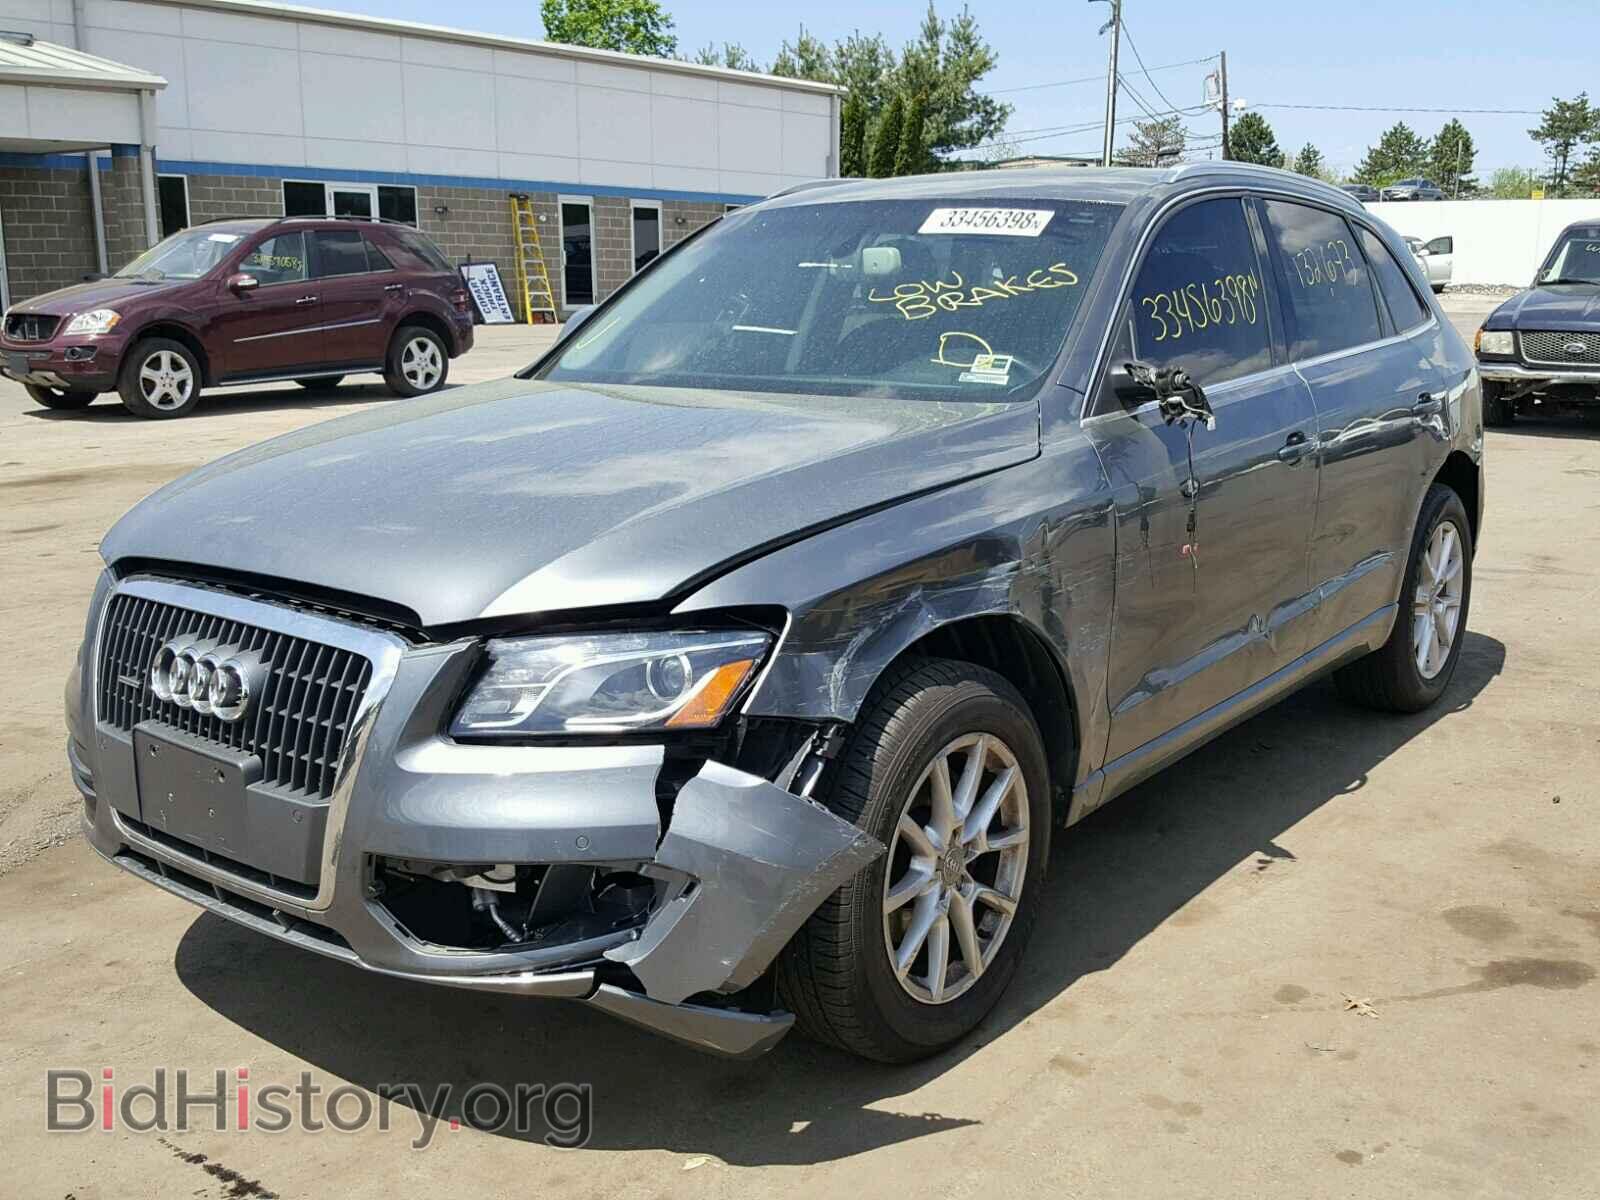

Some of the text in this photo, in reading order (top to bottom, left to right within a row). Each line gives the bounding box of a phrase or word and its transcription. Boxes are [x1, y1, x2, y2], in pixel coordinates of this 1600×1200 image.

[468, 277, 492, 314] COPART
[480, 278, 498, 310] TRUCK
[485, 266, 511, 320] ENTRANCE
[868, 271, 963, 301] LOW
[896, 263, 1078, 320] BRAKES
